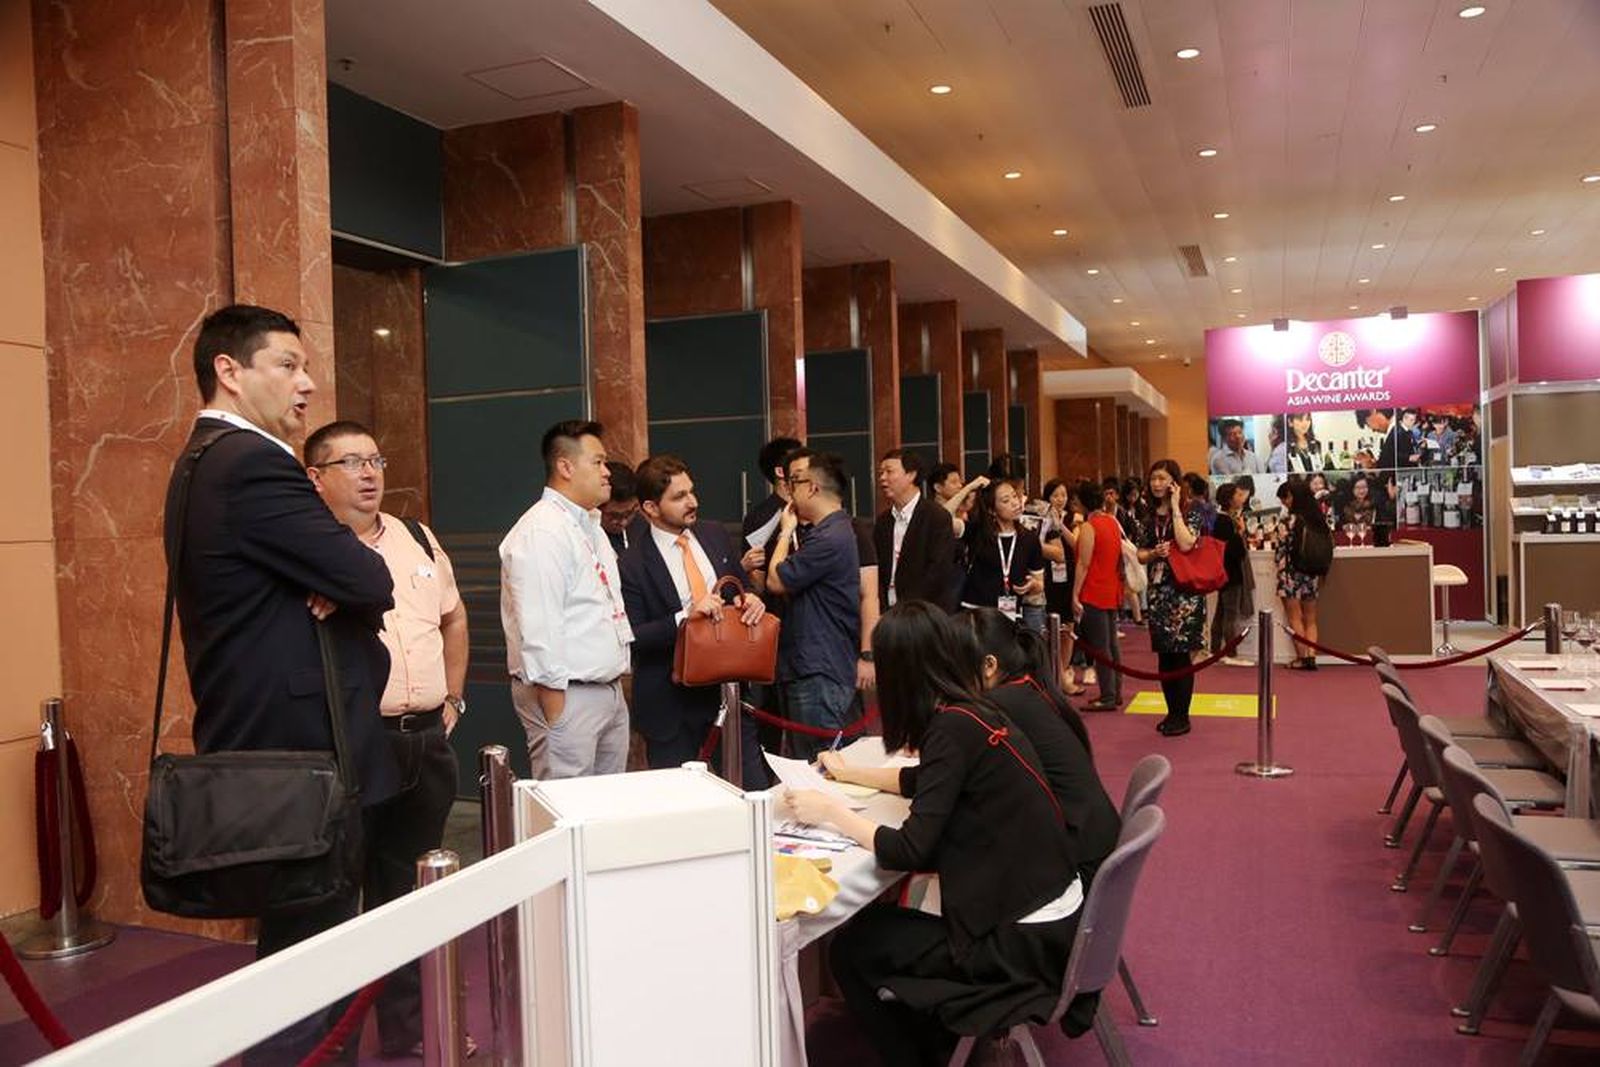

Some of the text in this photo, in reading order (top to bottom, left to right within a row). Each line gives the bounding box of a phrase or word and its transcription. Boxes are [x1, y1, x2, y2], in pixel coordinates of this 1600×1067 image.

[1286, 366, 1390, 393] Decanter
[1287, 391, 1391, 406] ASIA WINE AWARDS
